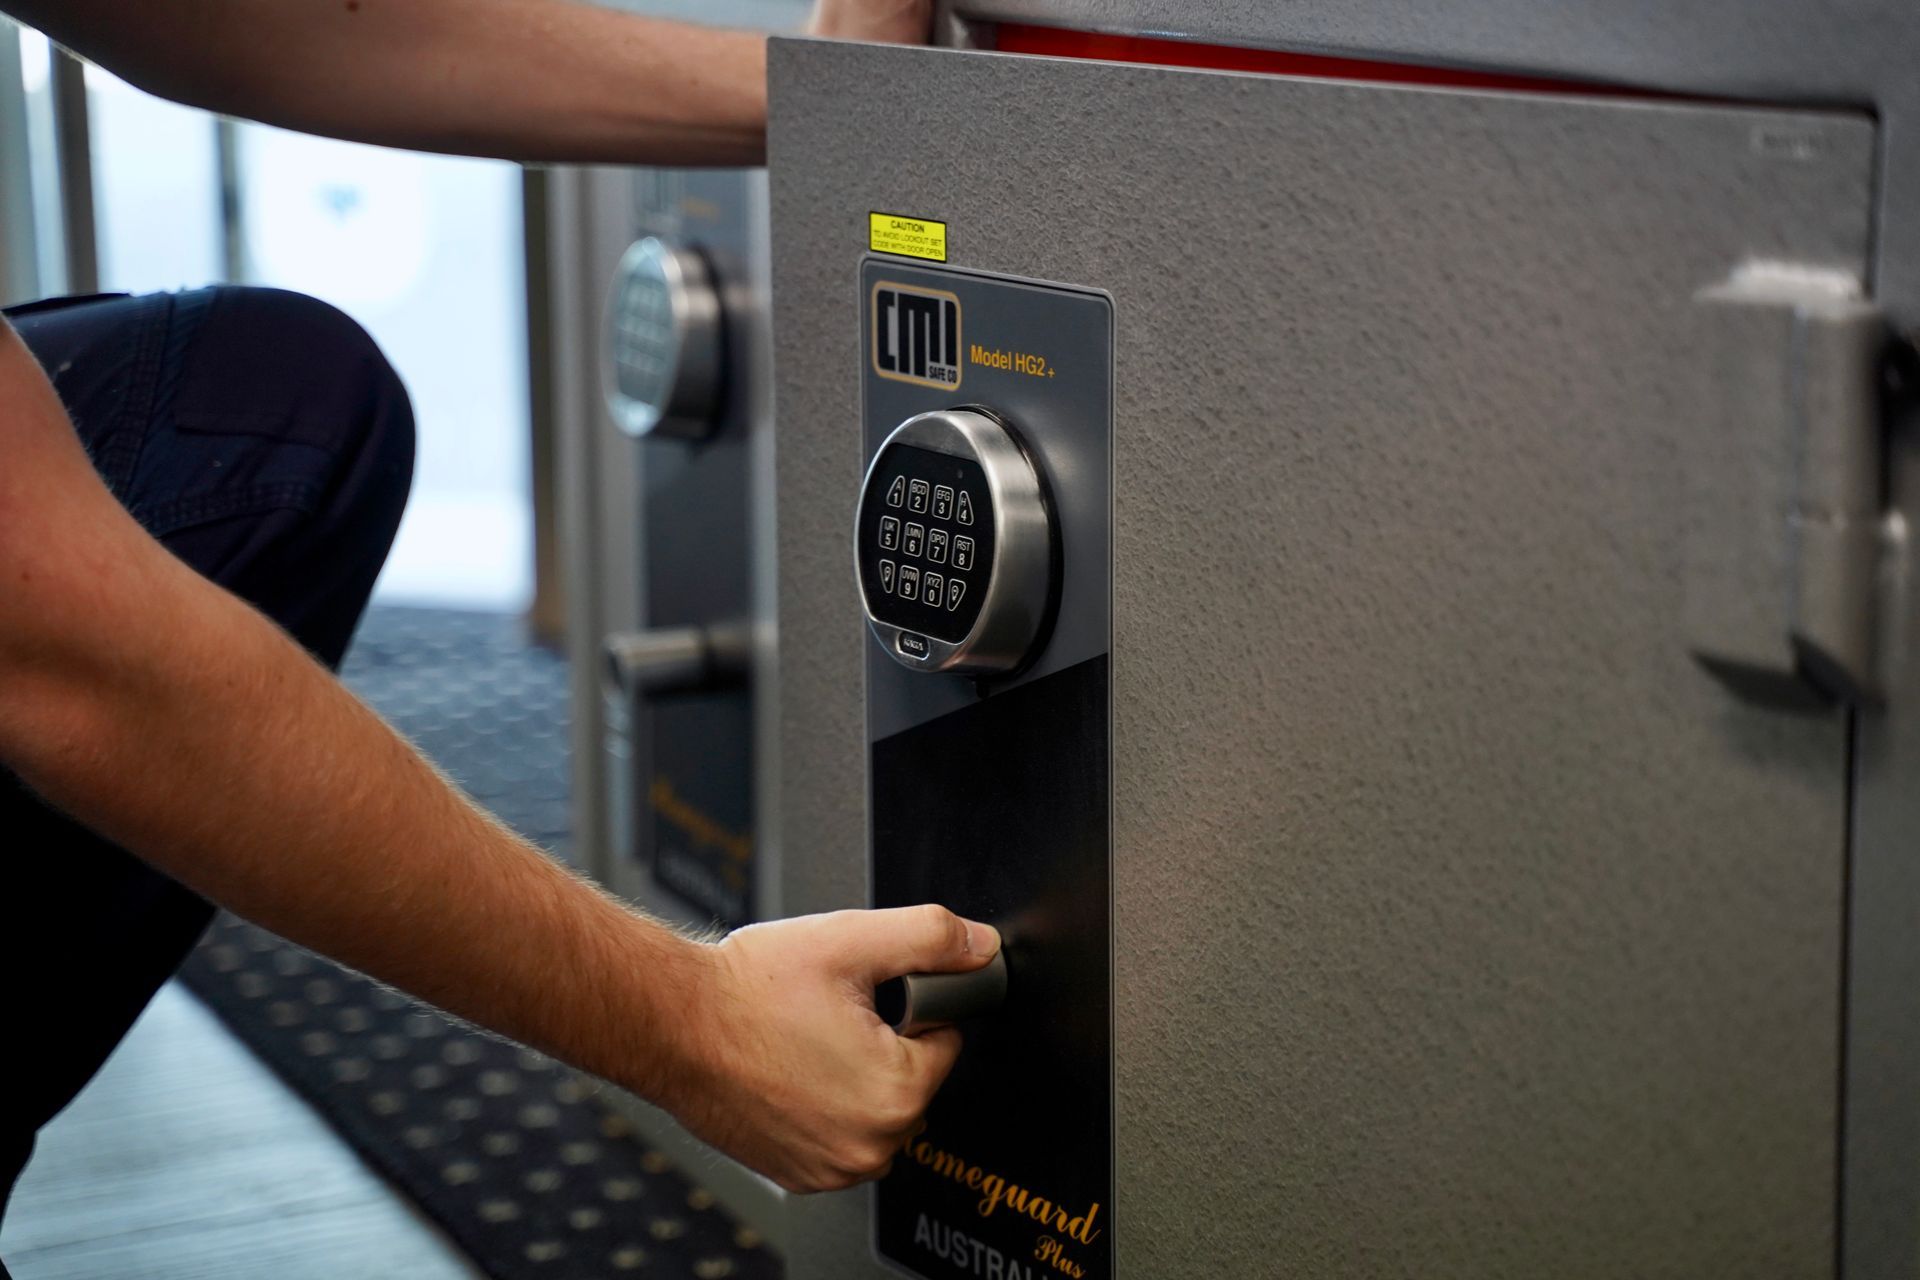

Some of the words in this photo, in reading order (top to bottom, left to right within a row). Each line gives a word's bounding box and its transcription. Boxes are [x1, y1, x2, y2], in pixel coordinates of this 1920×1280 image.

[891, 220, 925, 232] CAUTION
[873, 230, 881, 238] TO
[883, 231, 899, 240] AVOID
[931, 238, 942, 246] SET
[873, 239, 889, 248] CODE
[891, 242, 905, 250] WITH
[907, 245, 924, 254] DOOR
[926, 247, 943, 256] OPEN
[971, 345, 1012, 370] Model
[929, 365, 946, 381] SAFE
[947, 369, 957, 383] CO
[912, 483, 926, 495] BCD
[893, 492, 899, 504] 1
[914, 496, 921, 508] 2
[937, 490, 951, 502] EFG
[938, 502, 945, 514] 3
[961, 509, 967, 521] 4
[885, 533, 891, 545] 5
[909, 540, 916, 552] 6
[957, 540, 971, 551] RST
[934, 546, 940, 558] 7
[959, 553, 965, 566] 8
[927, 576, 941, 588] XYZ
[904, 582, 911, 595] 9
[914, 1212, 1048, 1280] AUSTRA
[1034, 1235, 1086, 1279] Plus
